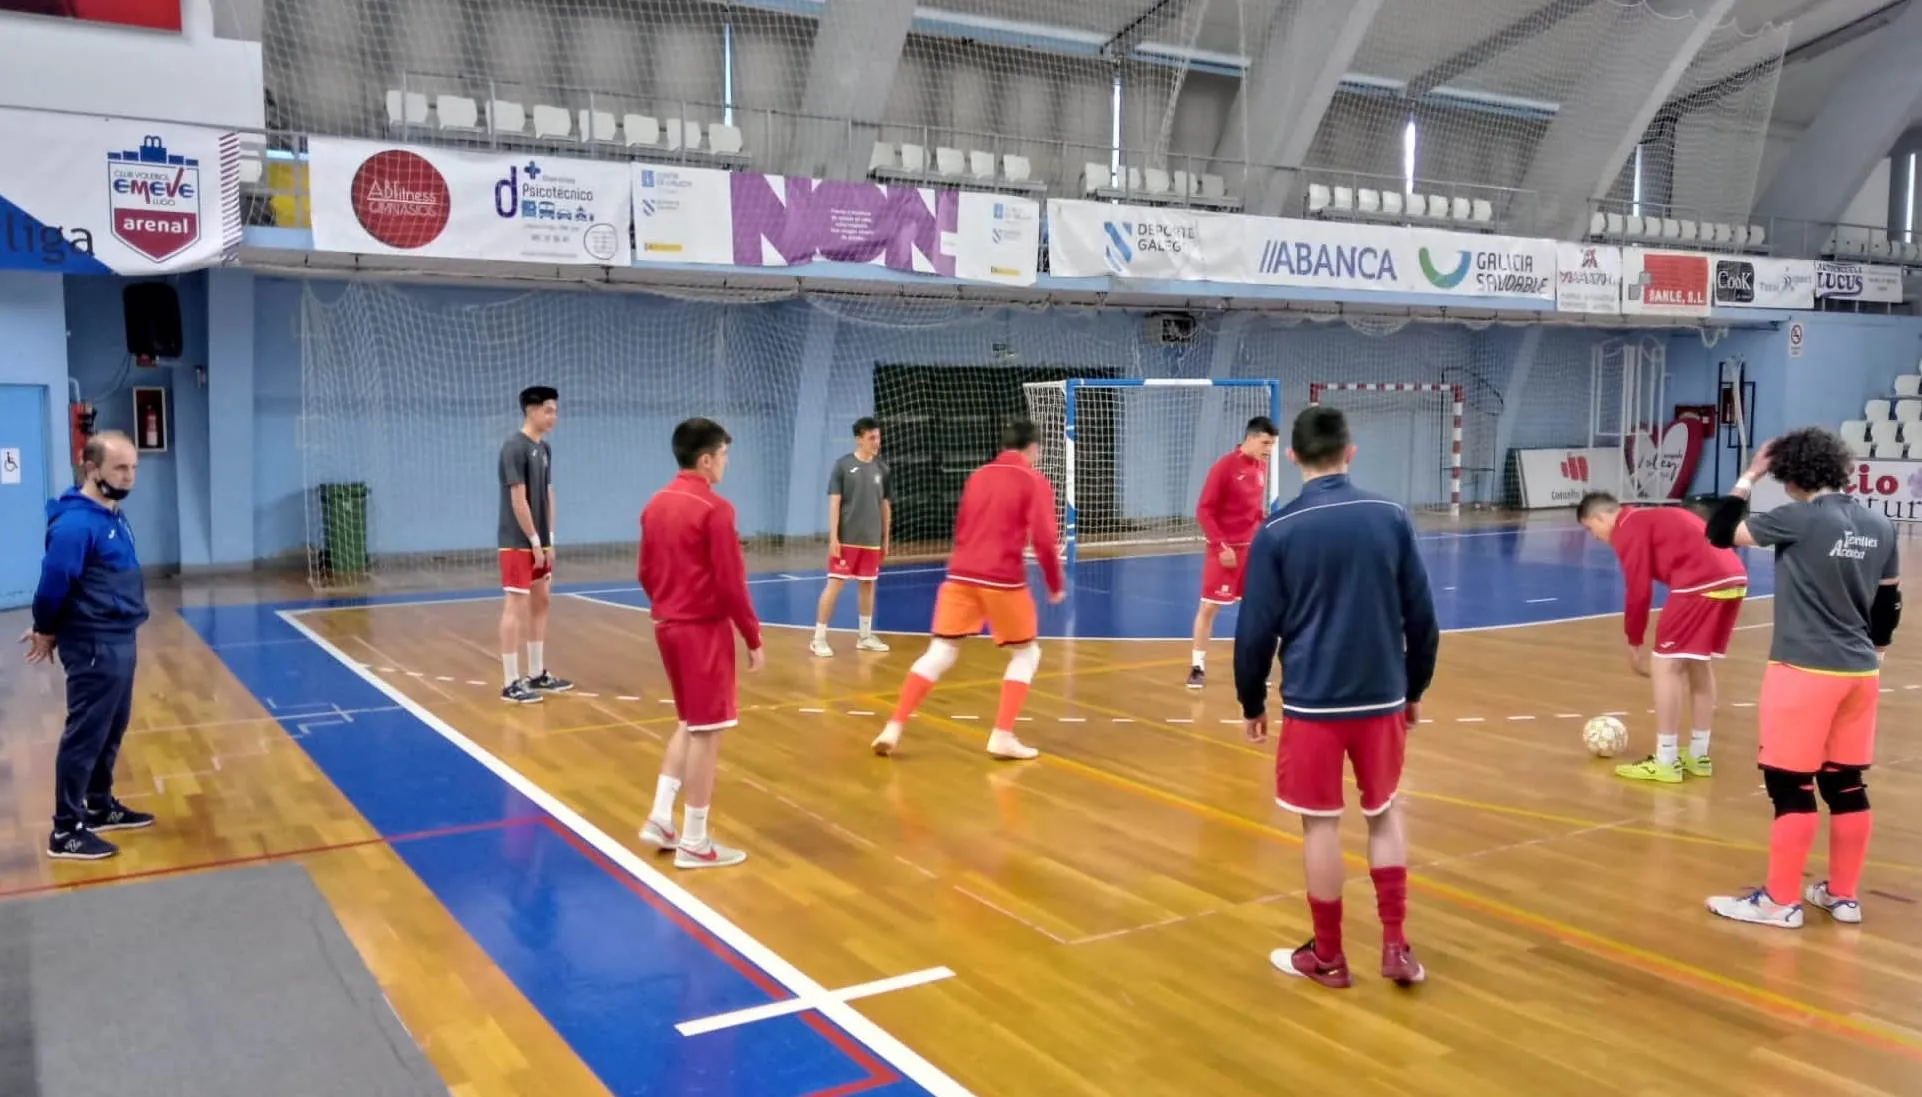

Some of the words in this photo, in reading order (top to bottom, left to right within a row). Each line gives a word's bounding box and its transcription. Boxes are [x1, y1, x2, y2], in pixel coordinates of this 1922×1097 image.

[123, 217, 188, 234] arenal
[1138, 222, 1196, 239] DEPOTE
[1476, 251, 1533, 273] GALICIA
[1817, 271, 1864, 293] LUCUS
